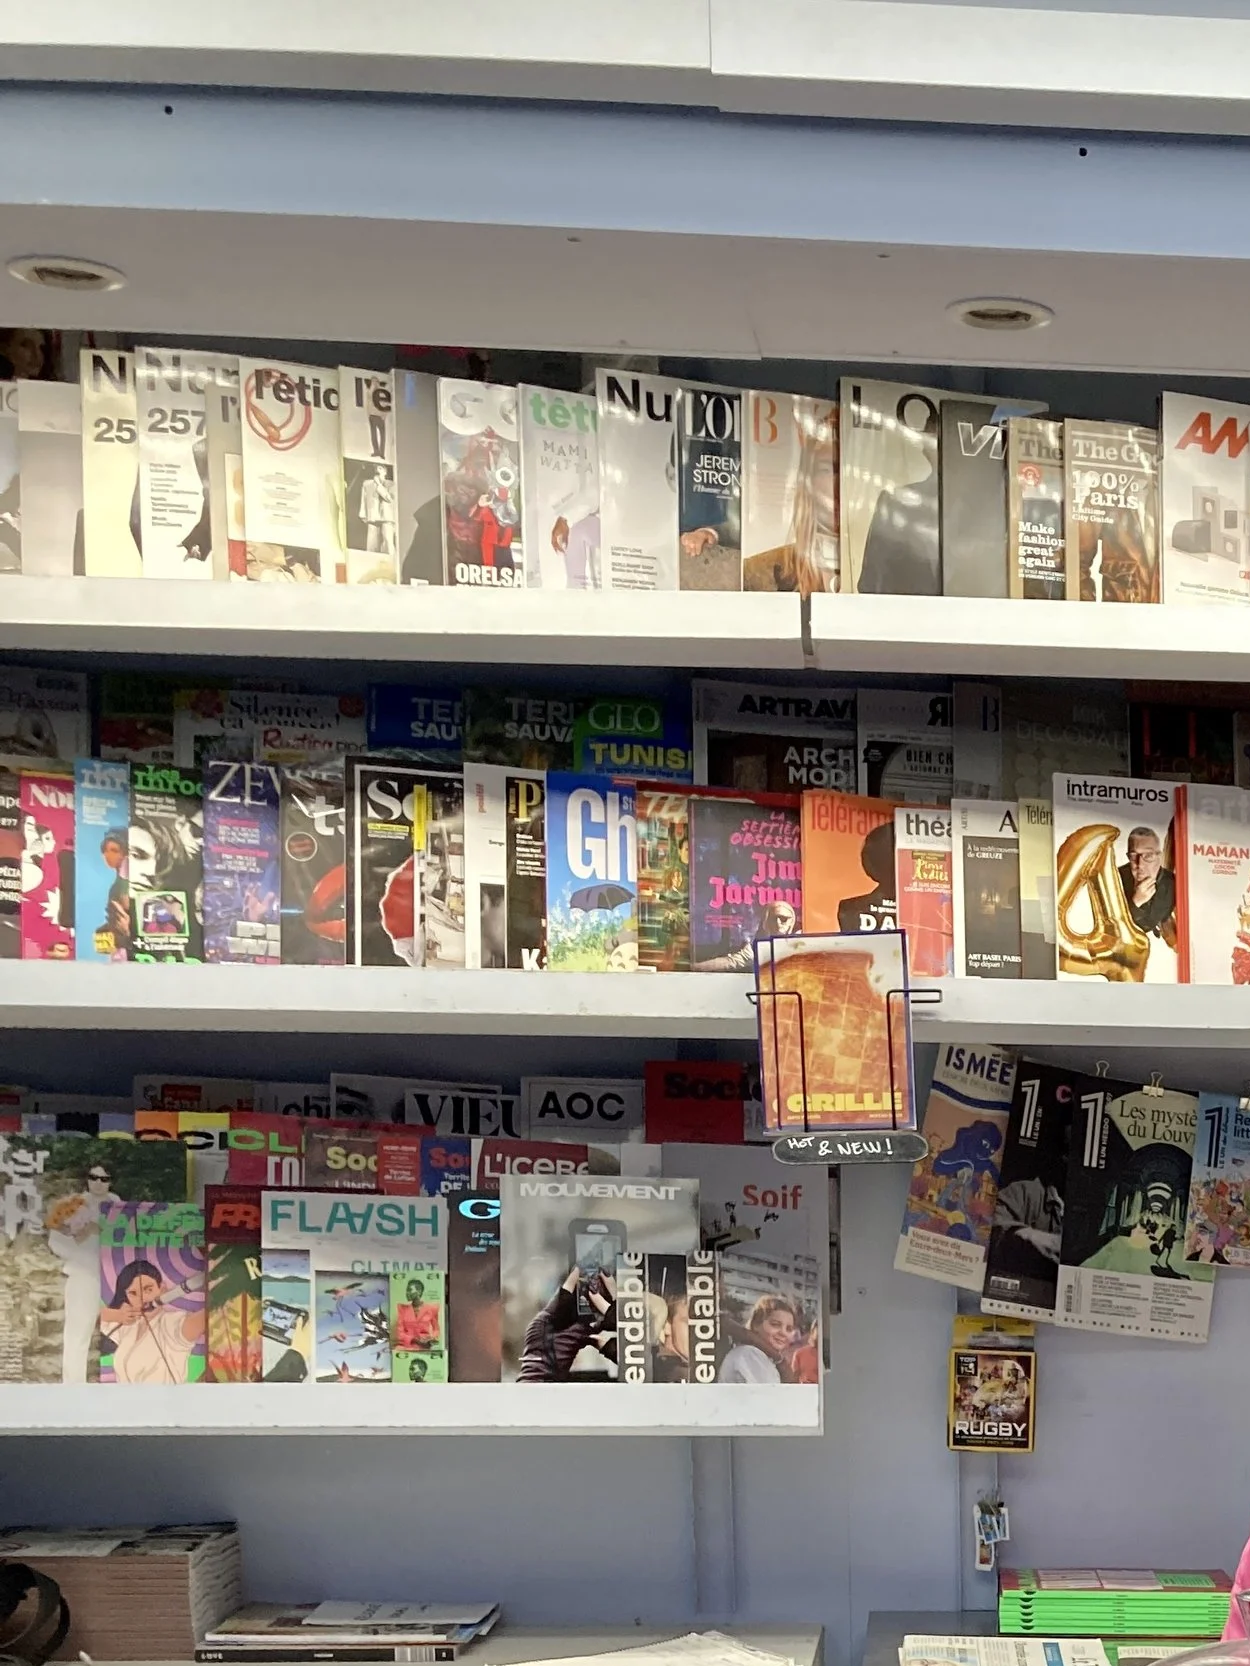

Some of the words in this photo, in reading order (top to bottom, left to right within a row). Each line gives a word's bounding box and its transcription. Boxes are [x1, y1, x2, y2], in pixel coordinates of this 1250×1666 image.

[147, 407, 206, 436] 257
[1072, 436, 1119, 462] The
[1066, 779, 1170, 803] intramuros
[537, 1090, 626, 1122] AOC
[1119, 1100, 1147, 1121] Les
[1126, 1119, 1148, 1138] du
[817, 1140, 834, 1157] &
[741, 1183, 804, 1211] Soif
[954, 1420, 1028, 1437] RUGBY
